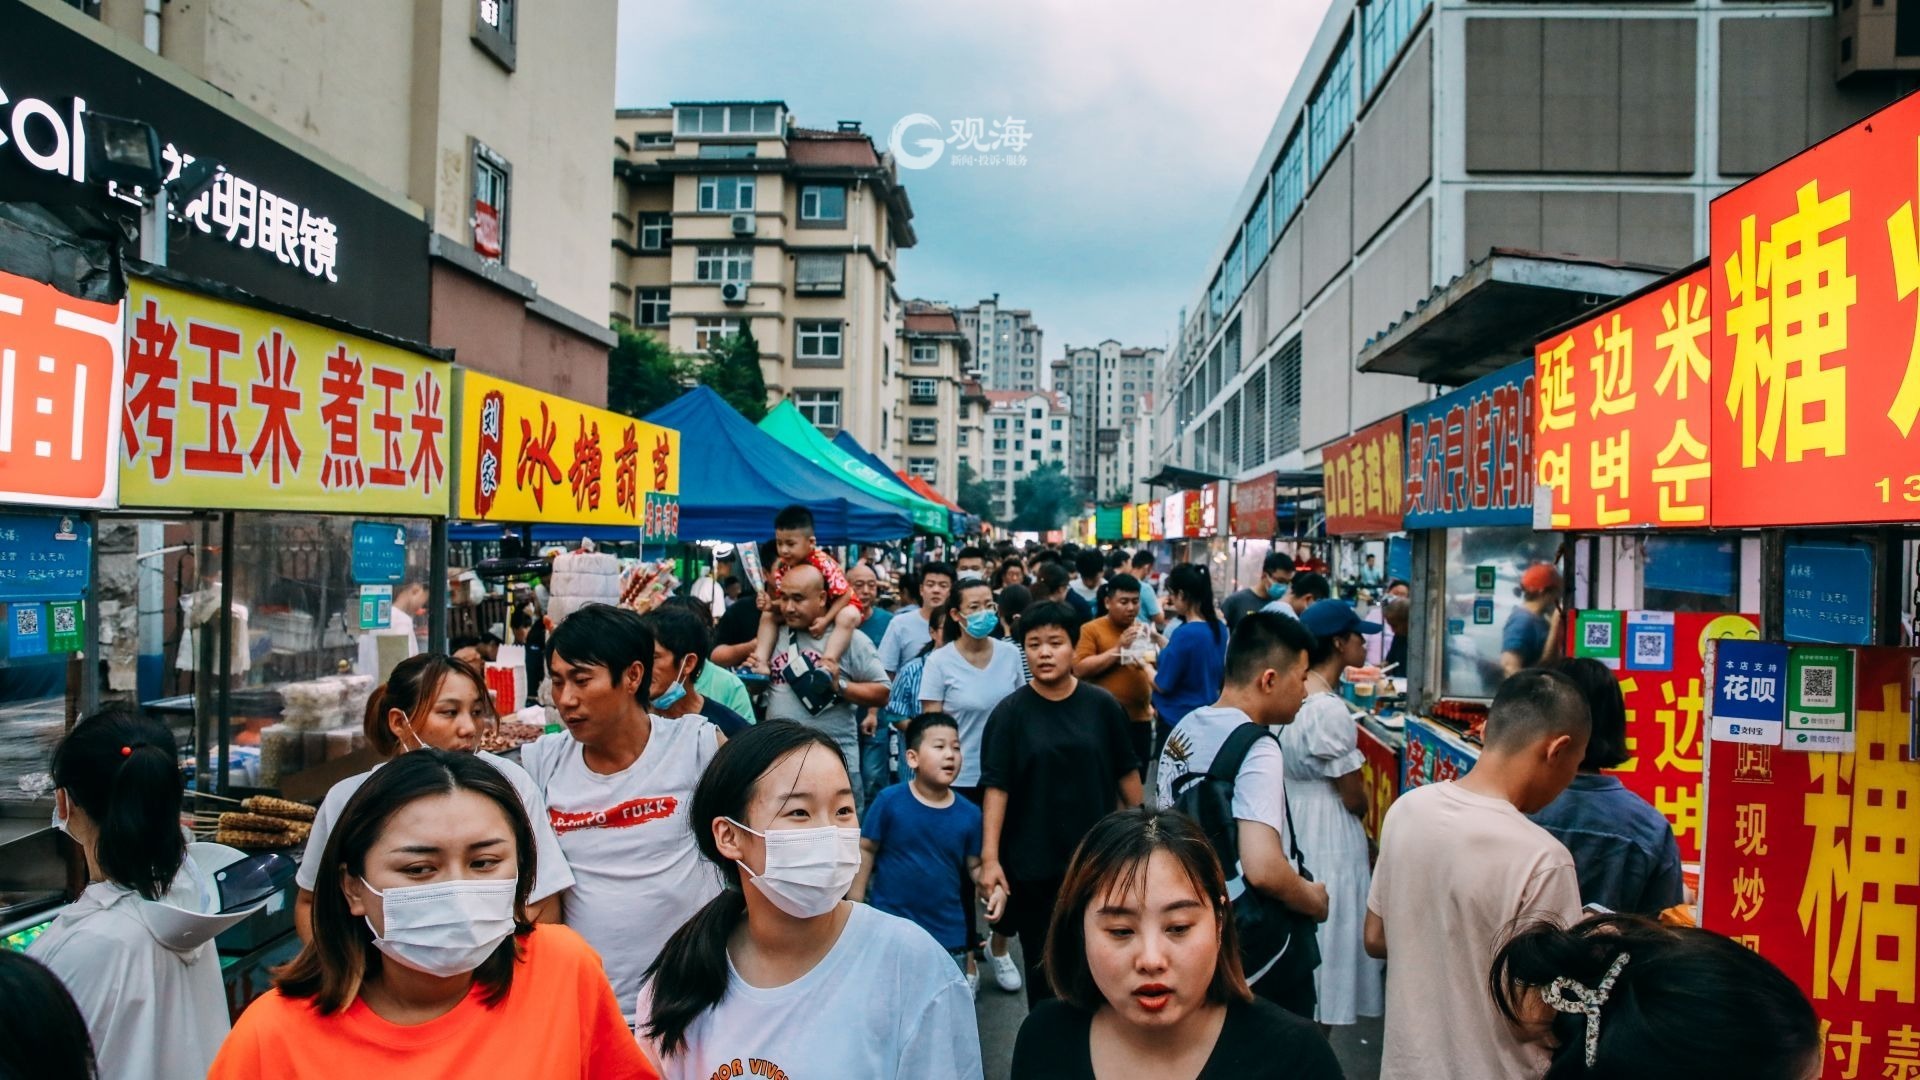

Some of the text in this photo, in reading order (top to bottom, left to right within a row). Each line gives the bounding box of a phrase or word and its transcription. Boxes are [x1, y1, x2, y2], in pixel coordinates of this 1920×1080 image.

[1539, 282, 1711, 434] 延边米
[124, 300, 444, 494] 烤玉米 煮玉米
[482, 398, 499, 497] 刘家
[516, 400, 670, 520] 冰糖葫芦
[1723, 674, 1776, 704] 花呗
[1725, 660, 1777, 673] 本店支持
[1741, 725, 1763, 736] 支付宝
[622, 799, 668, 819] FUKK
